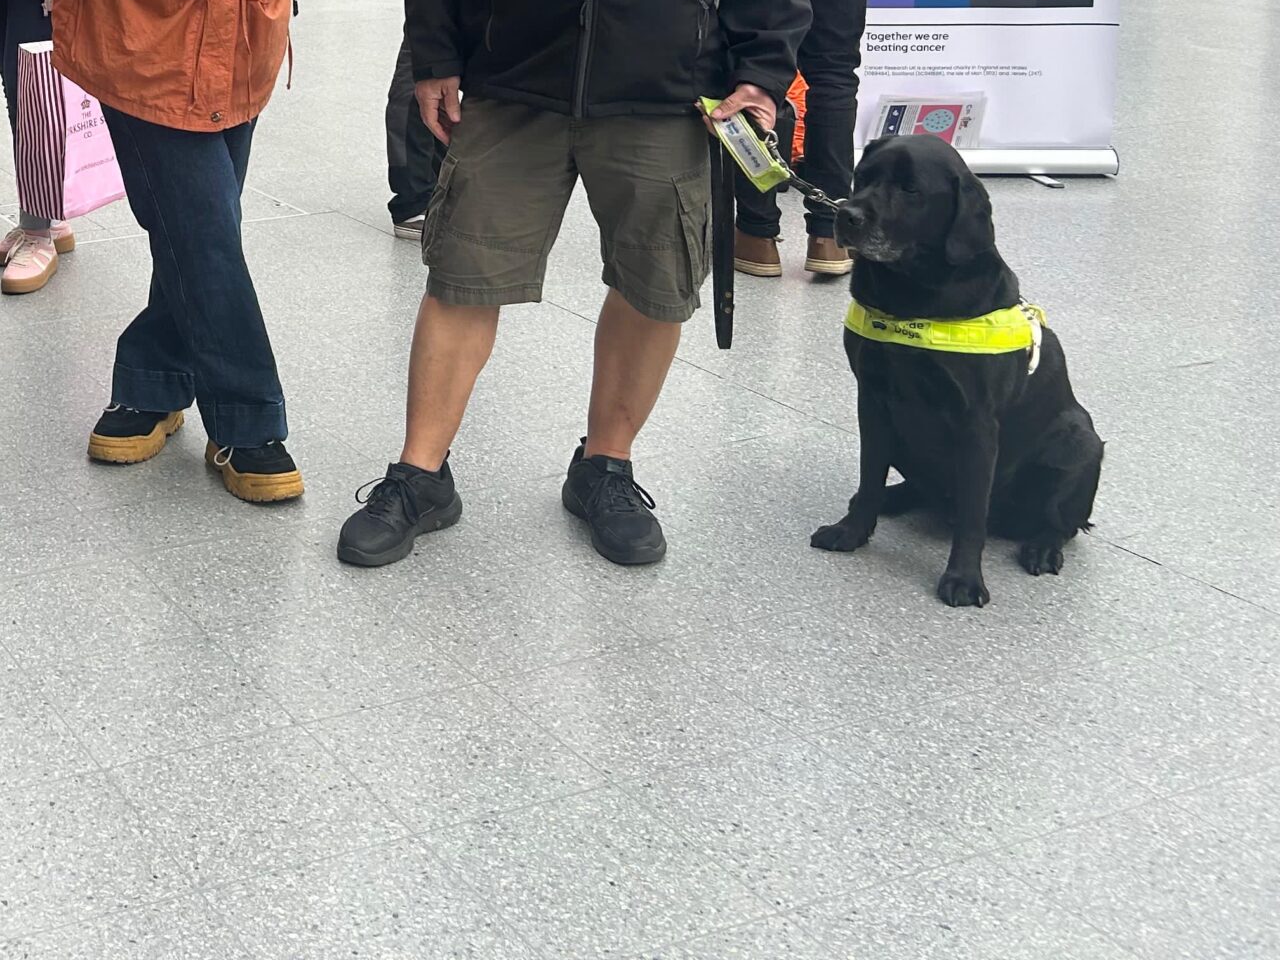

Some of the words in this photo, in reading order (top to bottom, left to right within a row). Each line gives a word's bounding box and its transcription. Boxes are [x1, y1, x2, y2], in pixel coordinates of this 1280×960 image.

[866, 32, 913, 42] Together
[914, 33, 930, 41] we
[931, 33, 949, 41] are
[866, 43, 908, 53] beating
[910, 44, 946, 52] cancer
[81, 111, 92, 120] THE
[68, 118, 98, 134] RKSHIRE
[83, 131, 93, 139] CO
[738, 138, 752, 156] Guide
